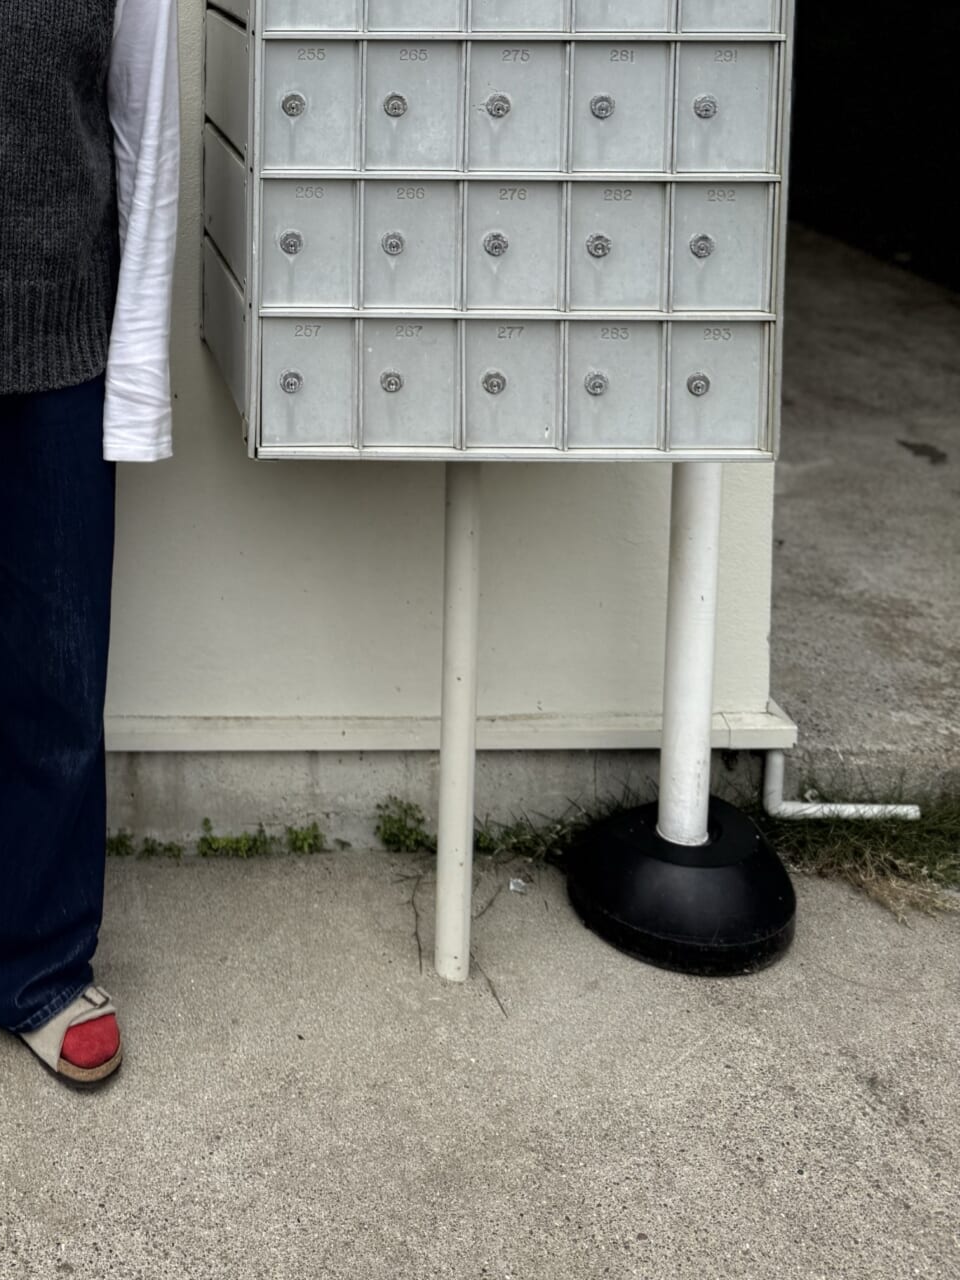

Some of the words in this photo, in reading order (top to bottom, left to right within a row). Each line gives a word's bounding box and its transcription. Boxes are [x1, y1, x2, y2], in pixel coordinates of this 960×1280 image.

[297, 48, 326, 62] 255
[399, 48, 428, 62] 265
[502, 49, 531, 63] 275
[609, 49, 635, 64] 281
[714, 49, 738, 64] 291
[396, 187, 425, 201] 266
[499, 188, 527, 202] 276
[707, 189, 736, 203] 292
[294, 325, 322, 338] 257
[395, 325, 423, 339] 267
[497, 326, 525, 341] 277
[703, 328, 732, 342] 293
